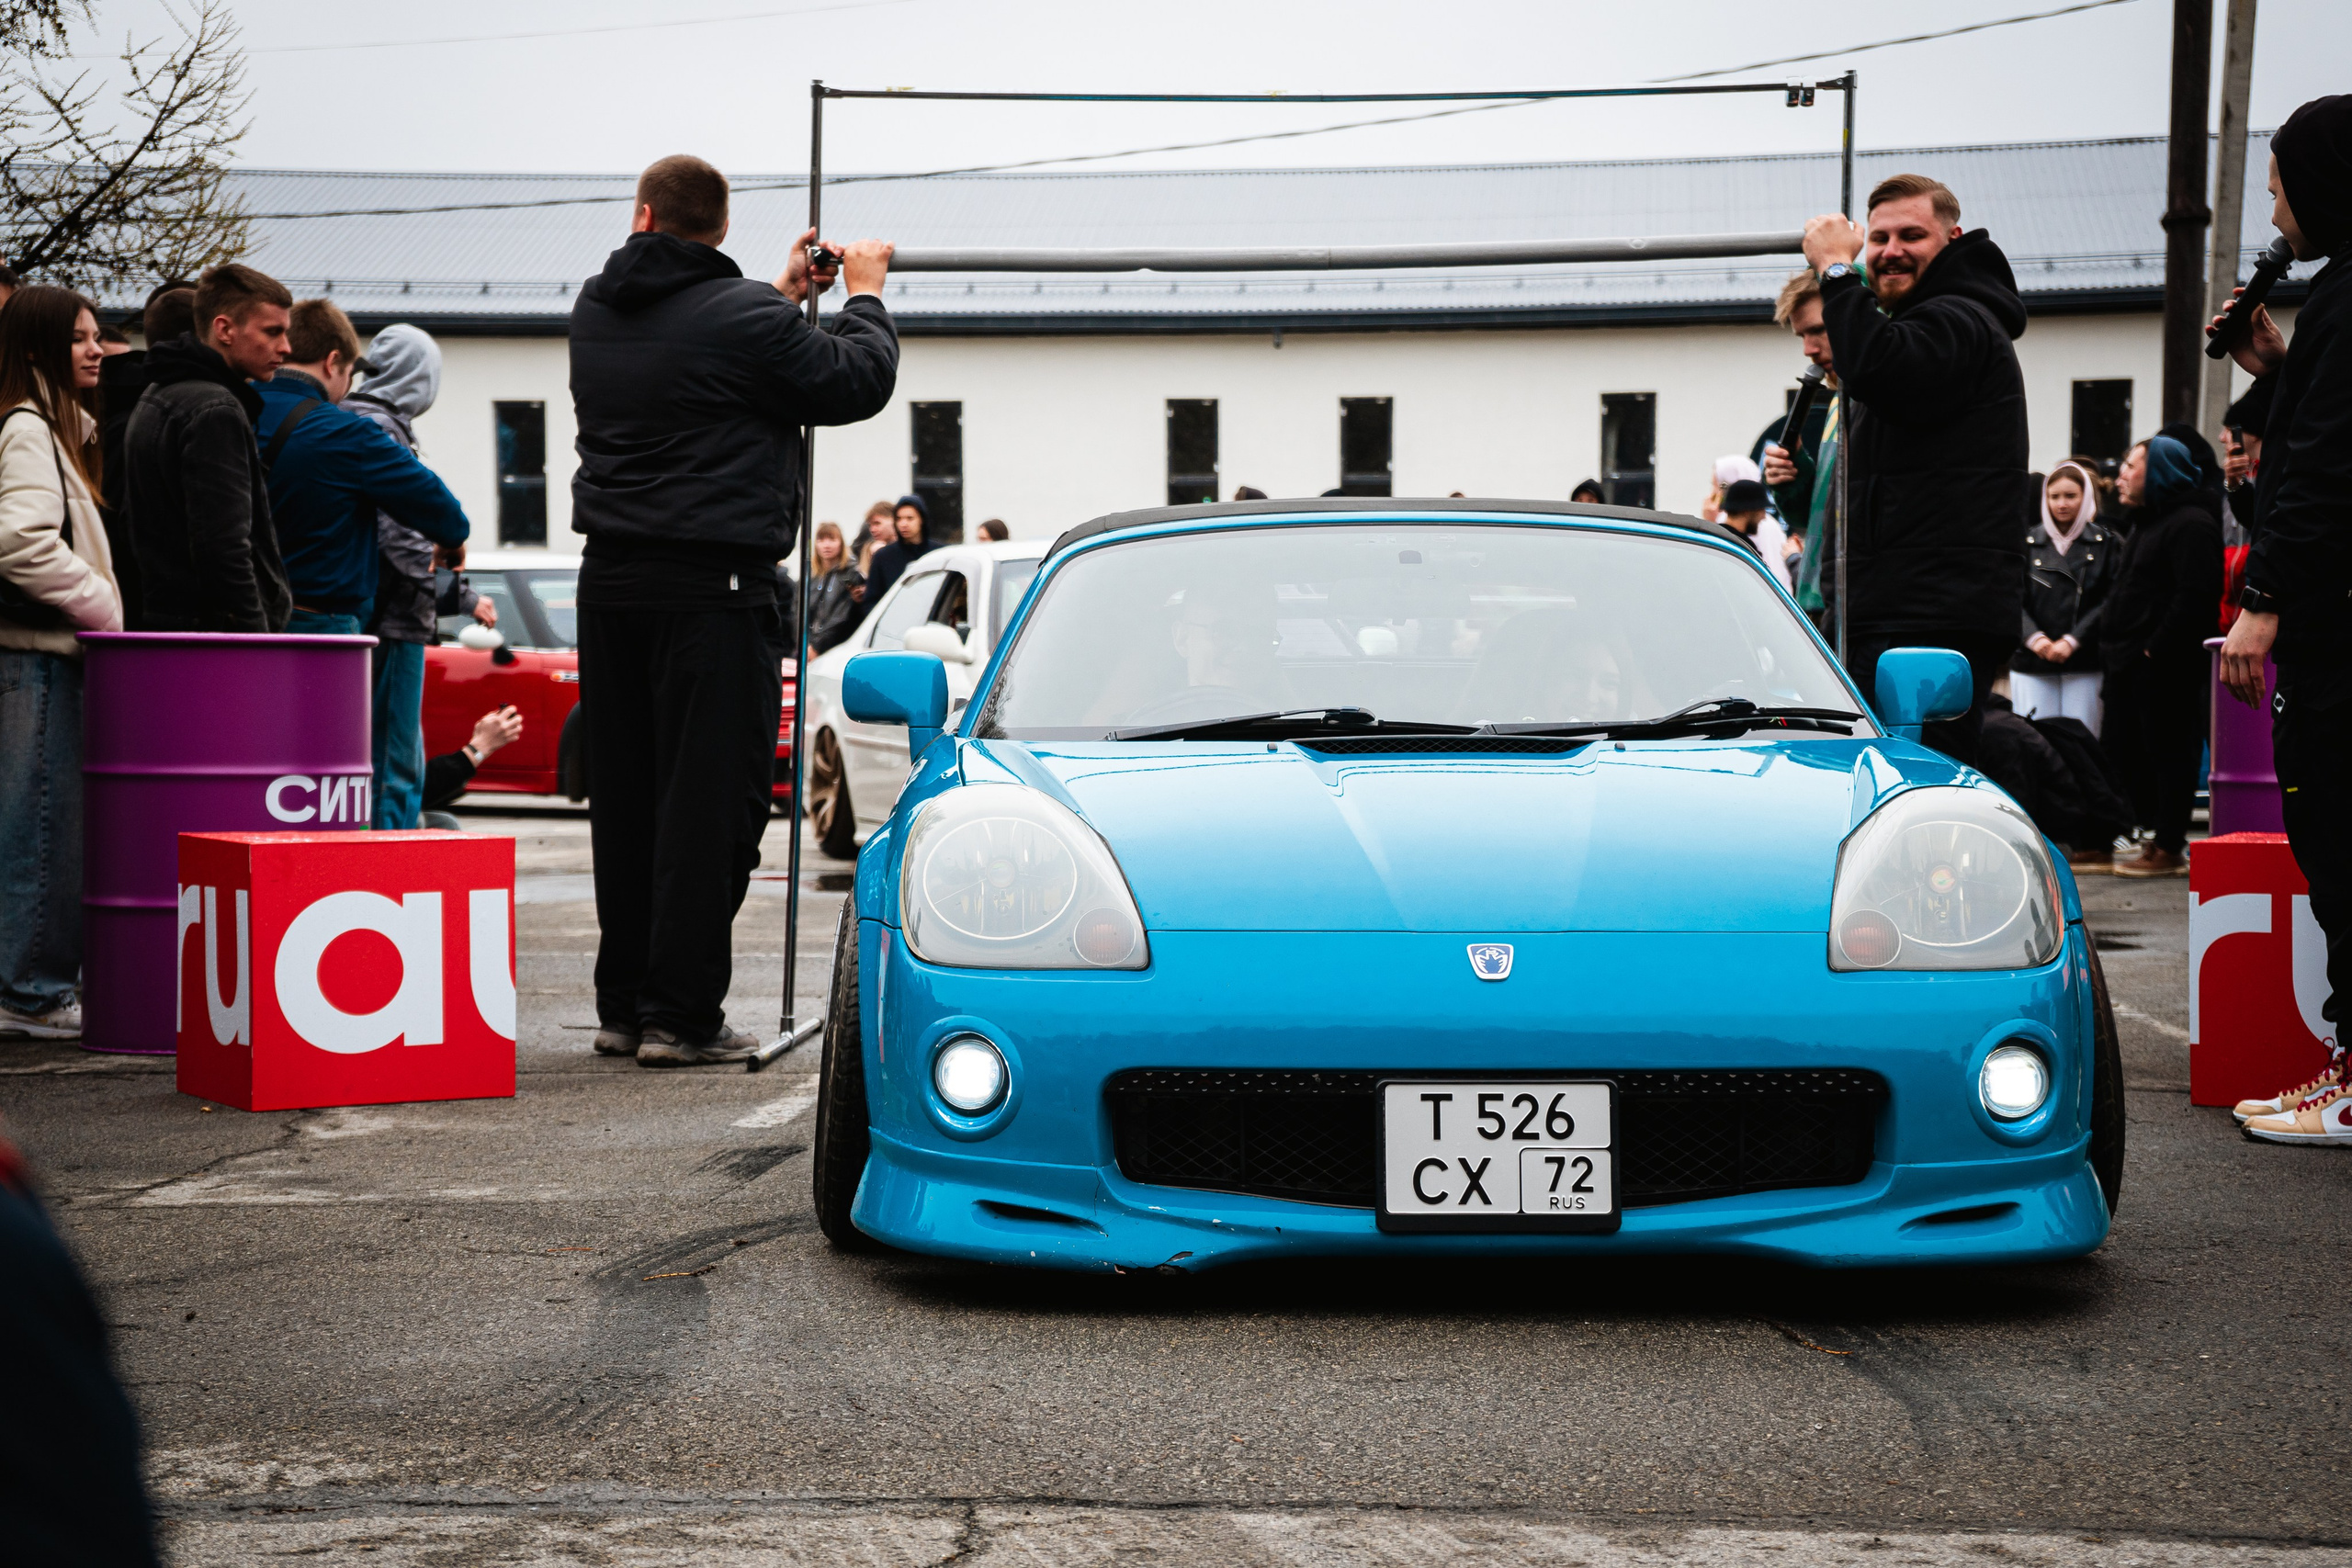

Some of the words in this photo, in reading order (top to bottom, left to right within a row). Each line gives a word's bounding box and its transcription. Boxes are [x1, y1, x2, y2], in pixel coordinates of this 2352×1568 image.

[1476, 1093, 1575, 1140] 526
[1544, 1156, 1594, 1192] 72
[1550, 1197, 1585, 1209] RUS
